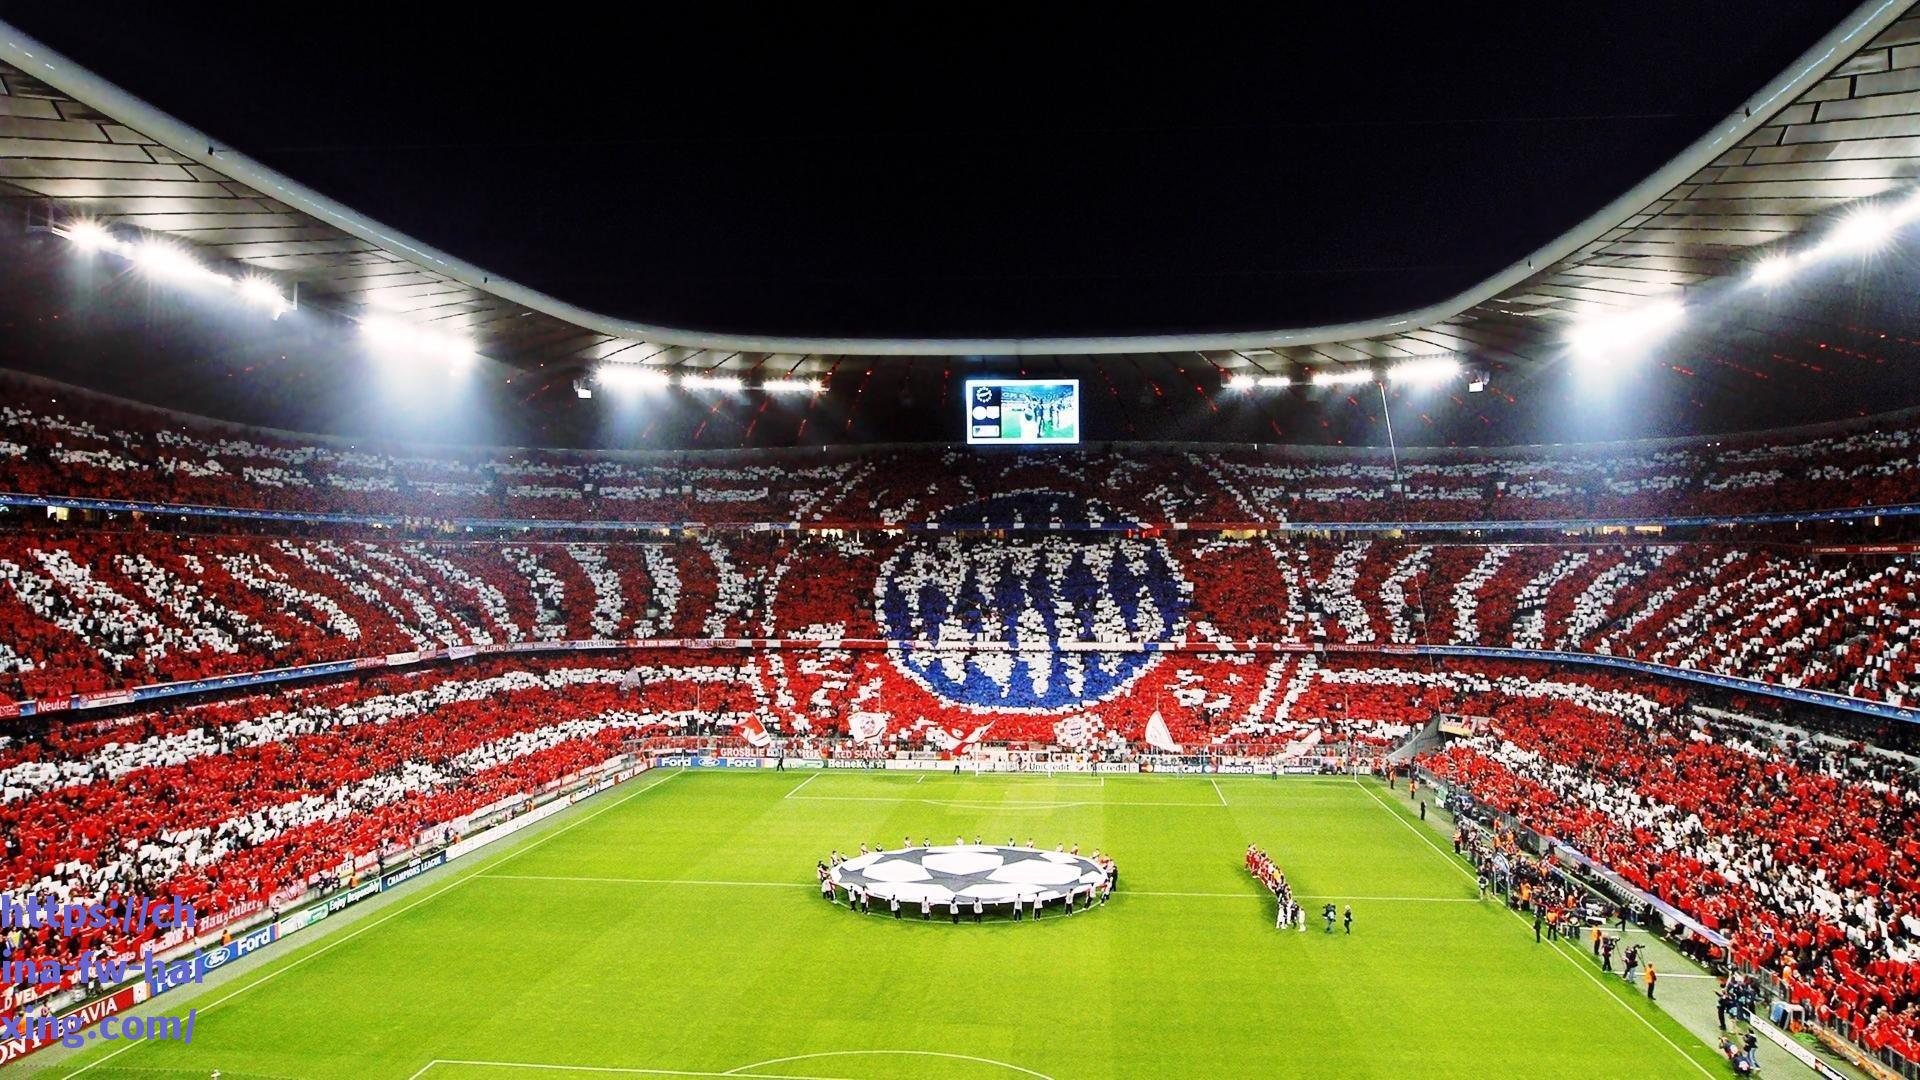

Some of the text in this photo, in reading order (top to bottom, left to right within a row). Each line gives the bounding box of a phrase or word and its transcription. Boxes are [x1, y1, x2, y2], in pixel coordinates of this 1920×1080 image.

[834, 749, 852, 759] RED
[854, 749, 889, 759] SHARKS
[661, 757, 692, 767] Ford
[726, 758, 757, 768] Ford
[828, 760, 875, 768] Heineken
[1029, 763, 1070, 771] UniCredit
[1086, 763, 1127, 772] UniCredit
[1218, 765, 1254, 774] Maestro
[387, 855, 442, 887] CHAMPIONS LEAGUE
[329, 897, 347, 912] Enjoy
[237, 926, 271, 956] Ford
